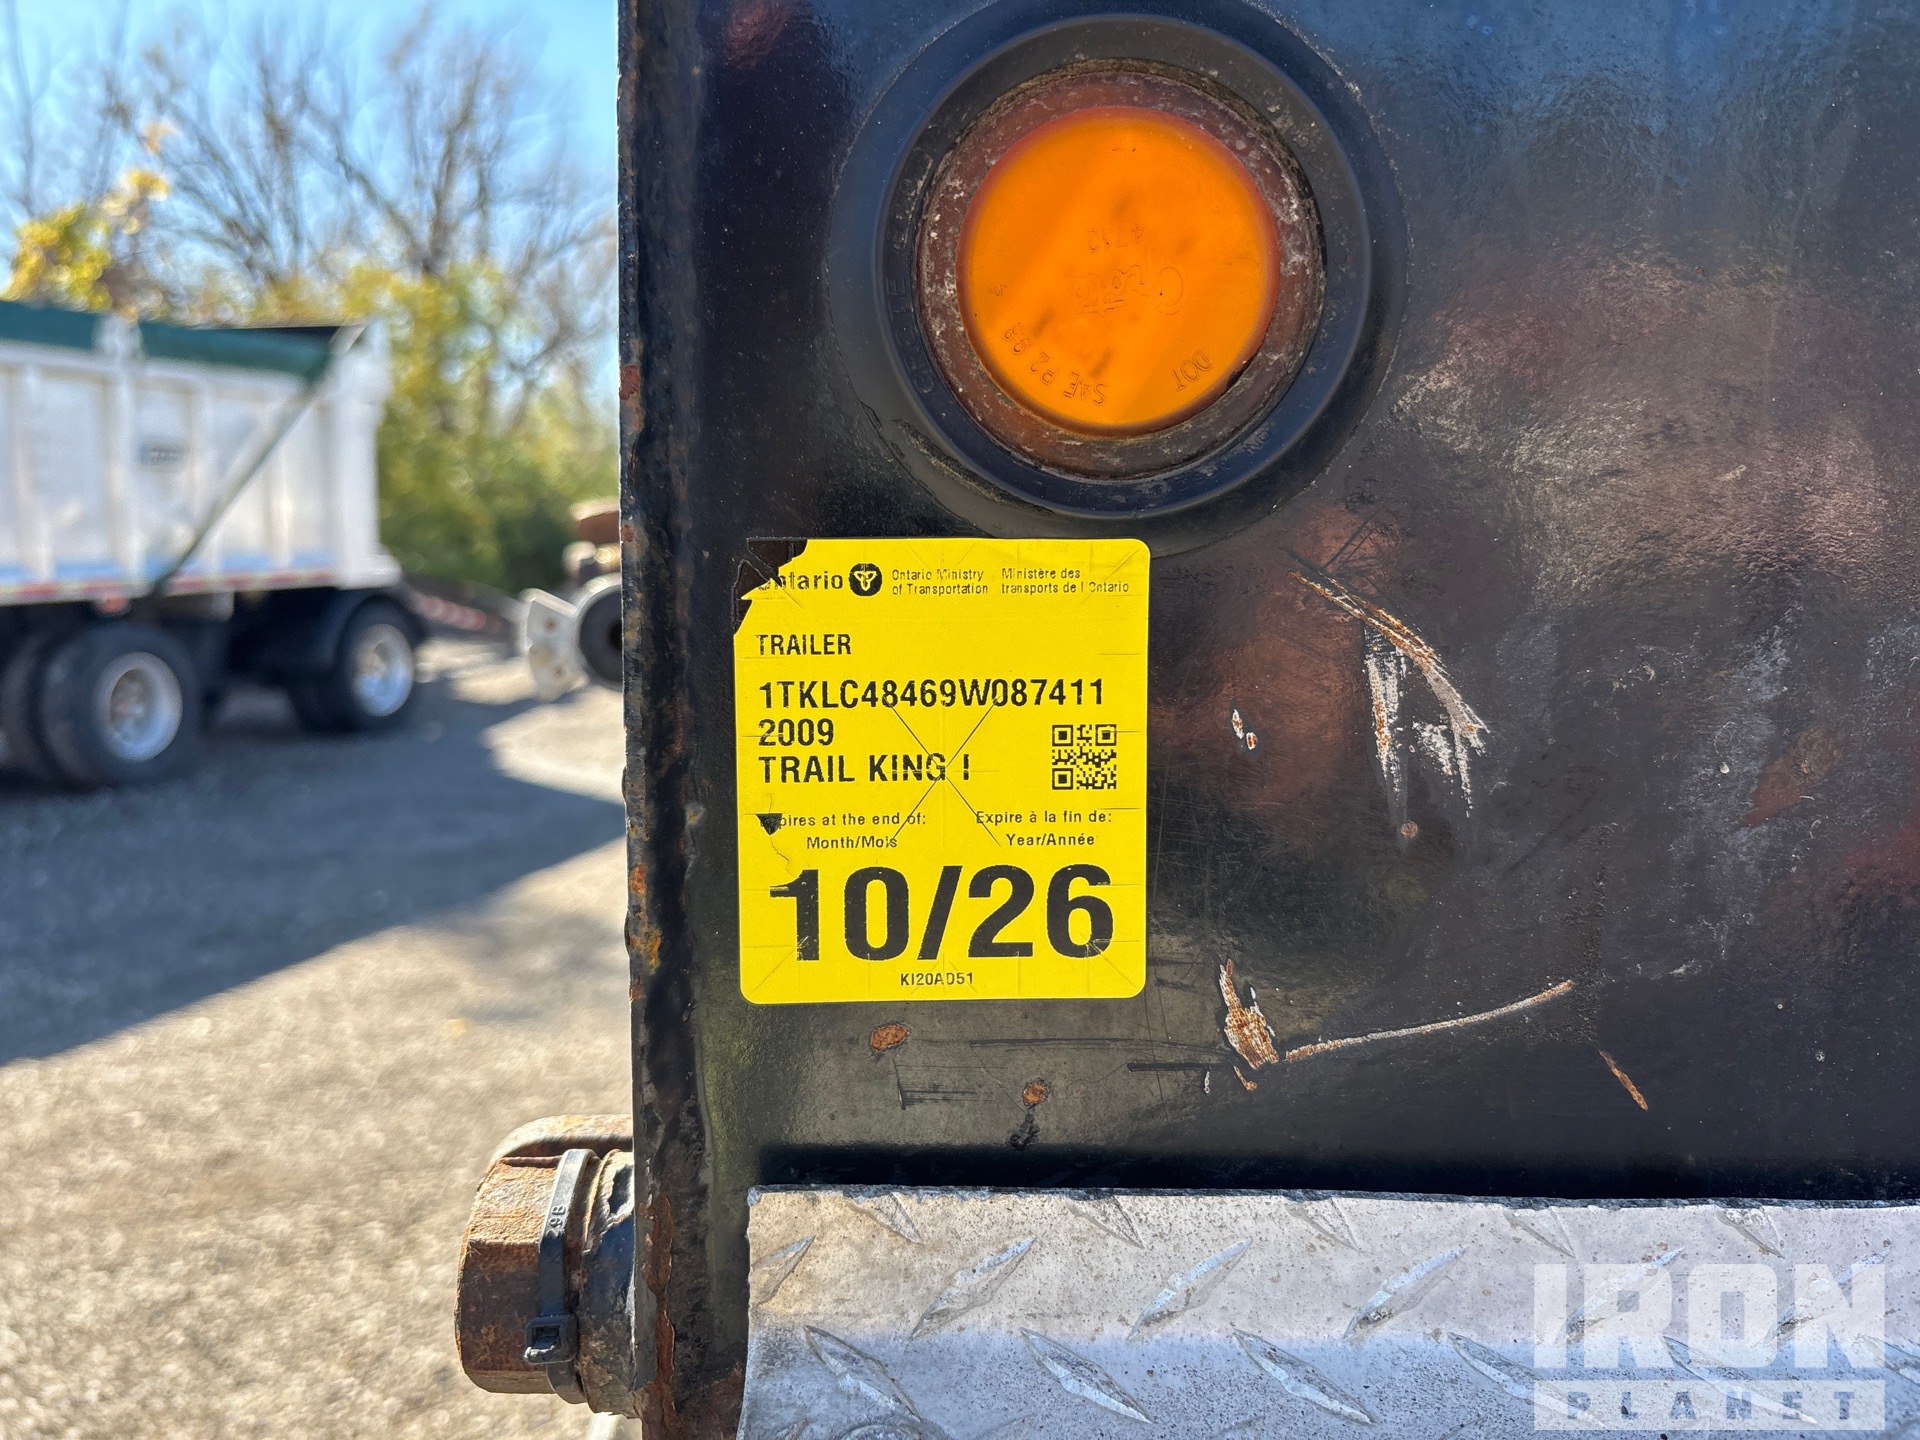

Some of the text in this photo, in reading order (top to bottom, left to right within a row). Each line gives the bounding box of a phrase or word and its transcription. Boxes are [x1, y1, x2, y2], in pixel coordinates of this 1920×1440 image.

[1171, 350, 1214, 392] DOT
[1063, 371, 1110, 406] SAE
[892, 569, 984, 582] Ontario Ministry
[1001, 568, 1081, 580] Ministère des
[892, 583, 988, 597] of Transportation
[1001, 582, 1059, 596] transports
[1062, 581, 1077, 593] de
[756, 633, 852, 656] TRAILER
[758, 678, 1104, 709] 1TKLC48469W087411
[757, 717, 835, 747] 2009
[758, 753, 971, 784] TRAIL KING I
[760, 812, 927, 831] pires at the end of:
[976, 809, 1113, 827] Expire à la fin de:
[806, 834, 898, 850] Month/Mois
[1005, 831, 1096, 847] Year/Année
[769, 863, 1114, 961] 10/26
